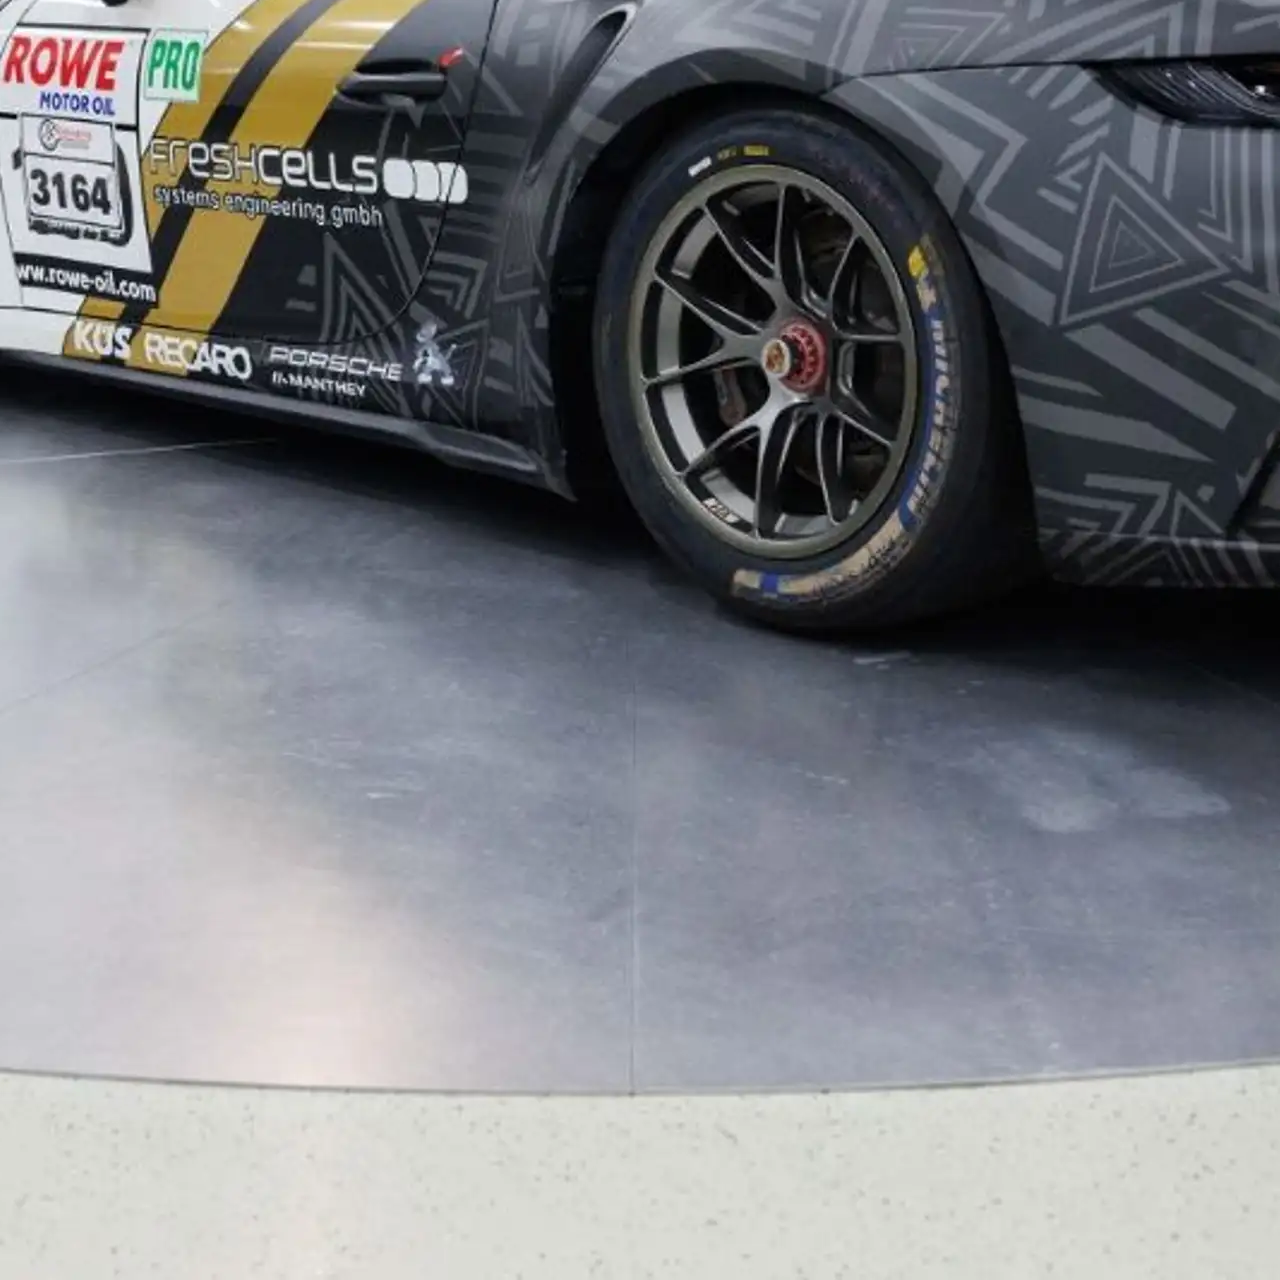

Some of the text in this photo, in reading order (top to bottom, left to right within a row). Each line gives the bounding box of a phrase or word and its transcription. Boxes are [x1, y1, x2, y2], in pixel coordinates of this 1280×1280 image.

[3, 35, 125, 91] ROWE
[147, 39, 201, 91] PRO
[39, 91, 116, 116] MOTOR OIL
[30, 168, 112, 215] 3164
[154, 185, 383, 228] systems engineering gmbh
[17, 265, 157, 302] ww.rowe-oil.com
[143, 333, 252, 380] RECARO
[270, 346, 402, 381] PORSCHE
[286, 372, 366, 397] MANTHEY
